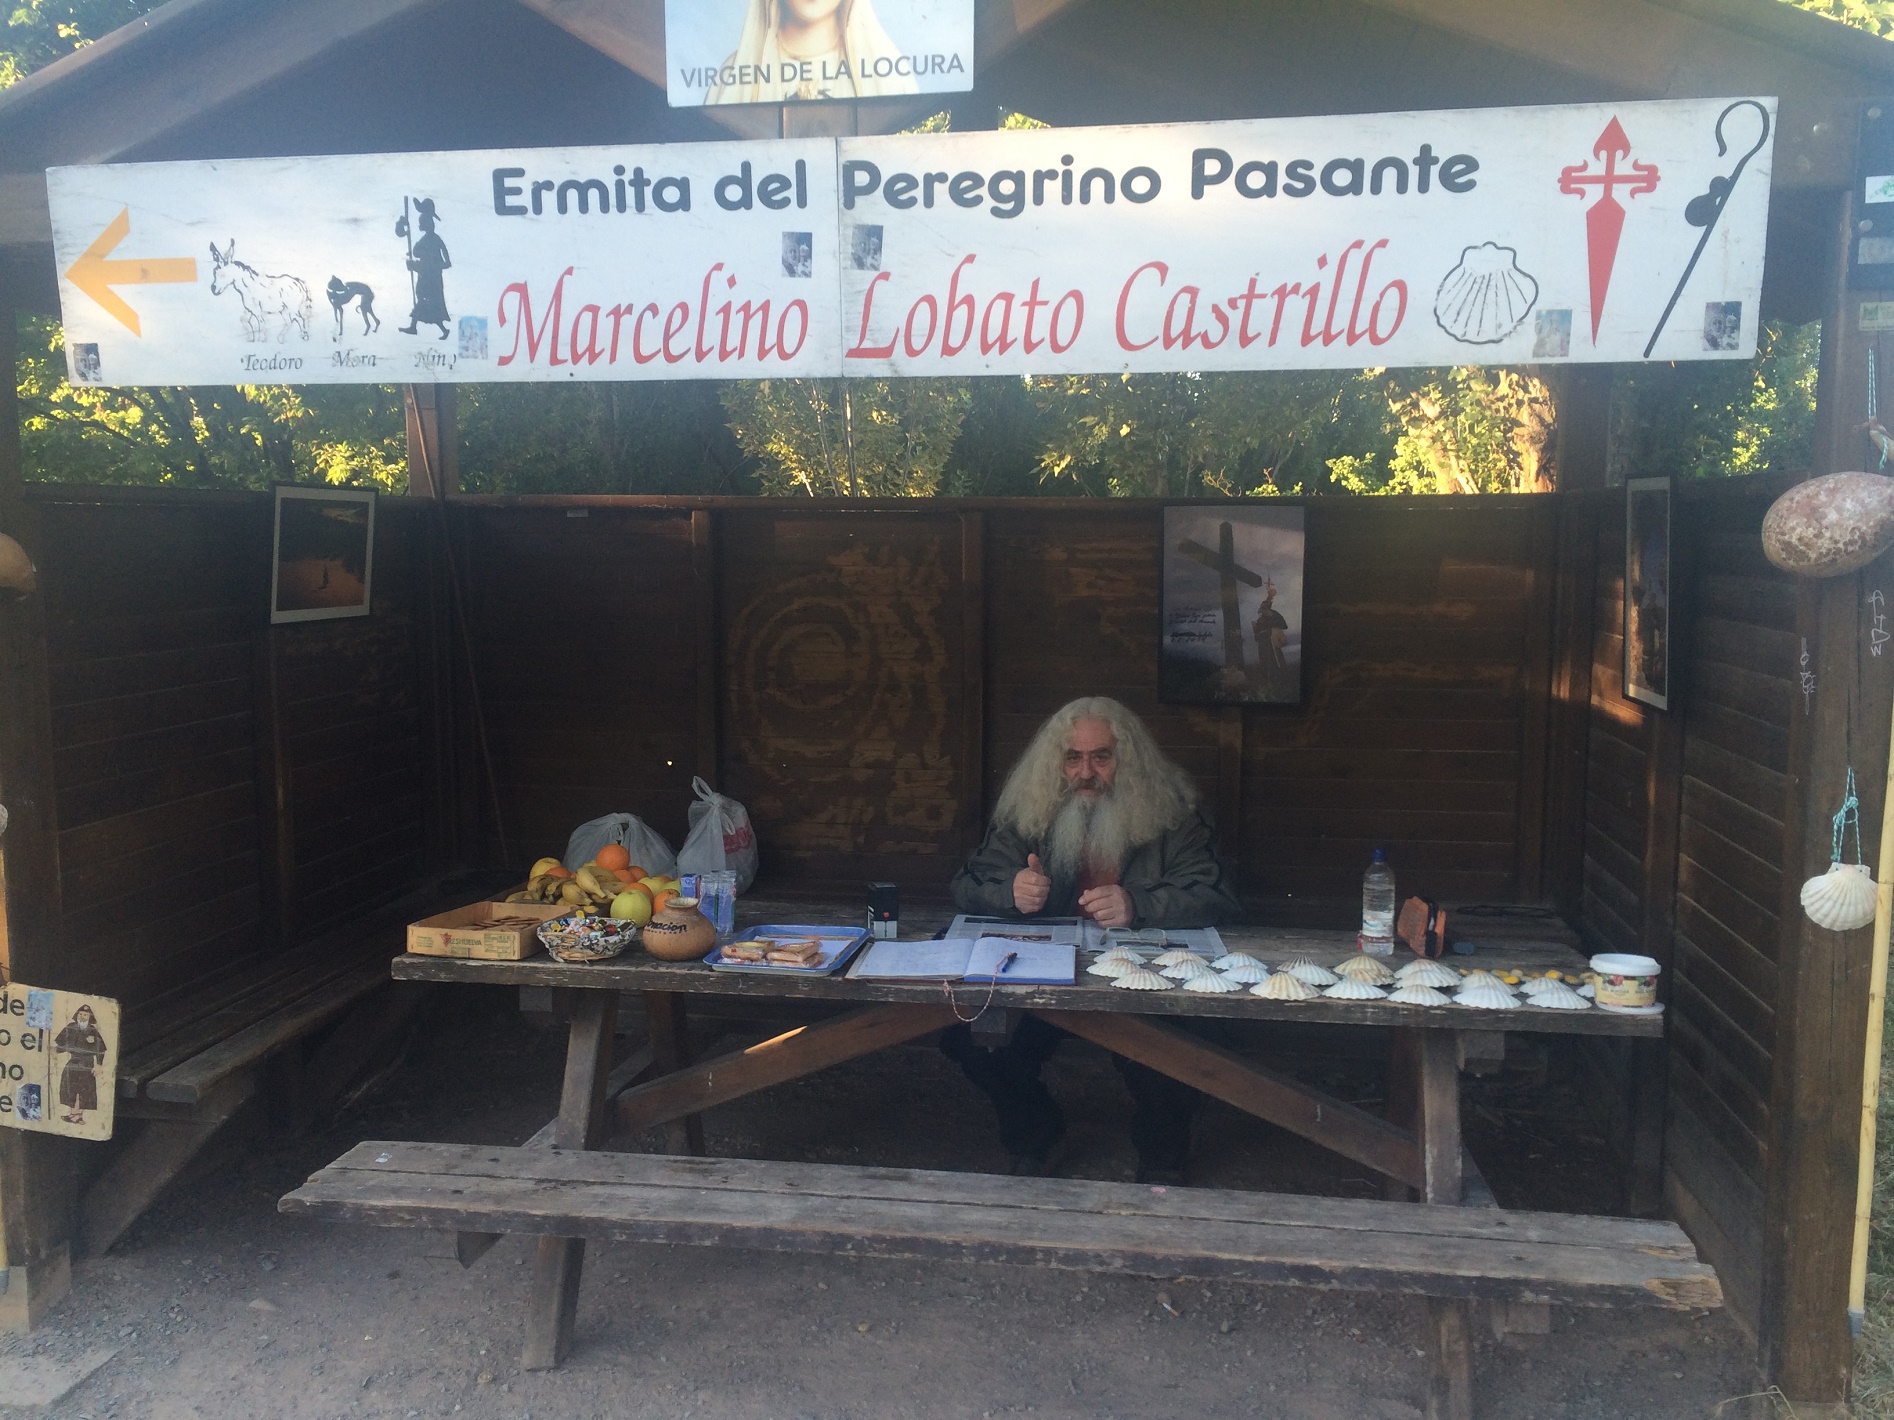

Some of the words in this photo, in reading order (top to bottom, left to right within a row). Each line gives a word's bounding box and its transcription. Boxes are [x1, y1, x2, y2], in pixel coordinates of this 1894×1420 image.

[680, 63, 771, 88] VIRGEN
[780, 62, 813, 82] DE
[822, 59, 855, 81] LA
[860, 53, 966, 78] LOCURA
[492, 164, 692, 216] Ermita
[714, 159, 808, 212] del
[841, 153, 1162, 219] Peregrino
[1191, 143, 1480, 200] Pasante
[497, 262, 809, 367] Marcelino
[844, 253, 1085, 360] Lobato
[1115, 238, 1409, 353] Castrillo
[20, 1029, 43, 1052] el
